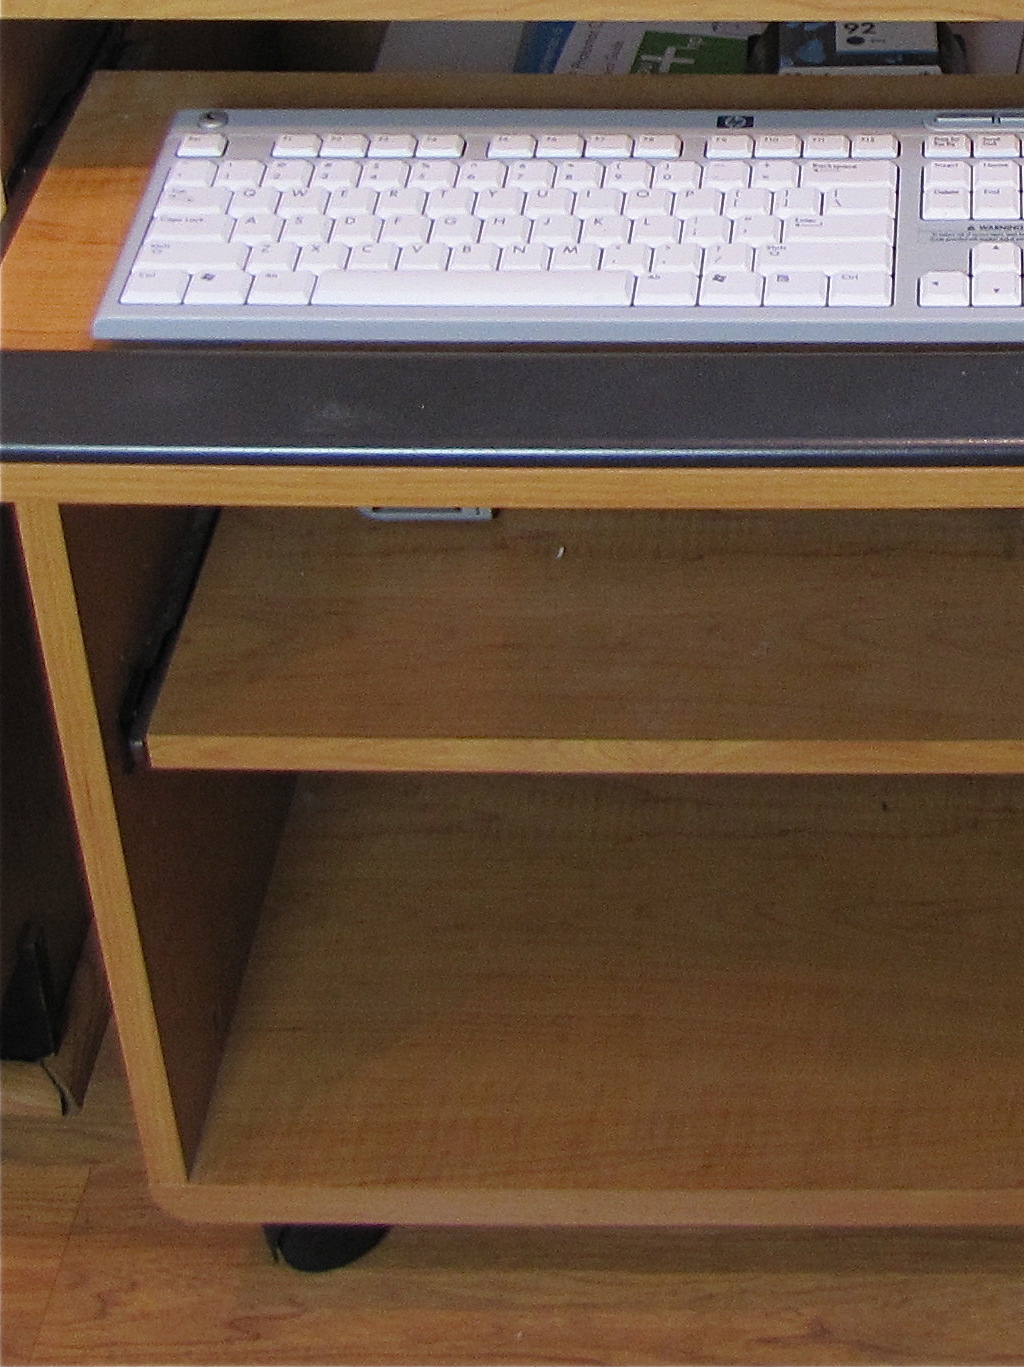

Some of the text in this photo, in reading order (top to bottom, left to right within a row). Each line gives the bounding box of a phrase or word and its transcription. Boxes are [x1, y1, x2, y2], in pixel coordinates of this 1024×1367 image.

[844, 22, 876, 34] 92
[643, 217, 651, 225] L
[362, 245, 372, 253] C
[563, 246, 578, 254] M
